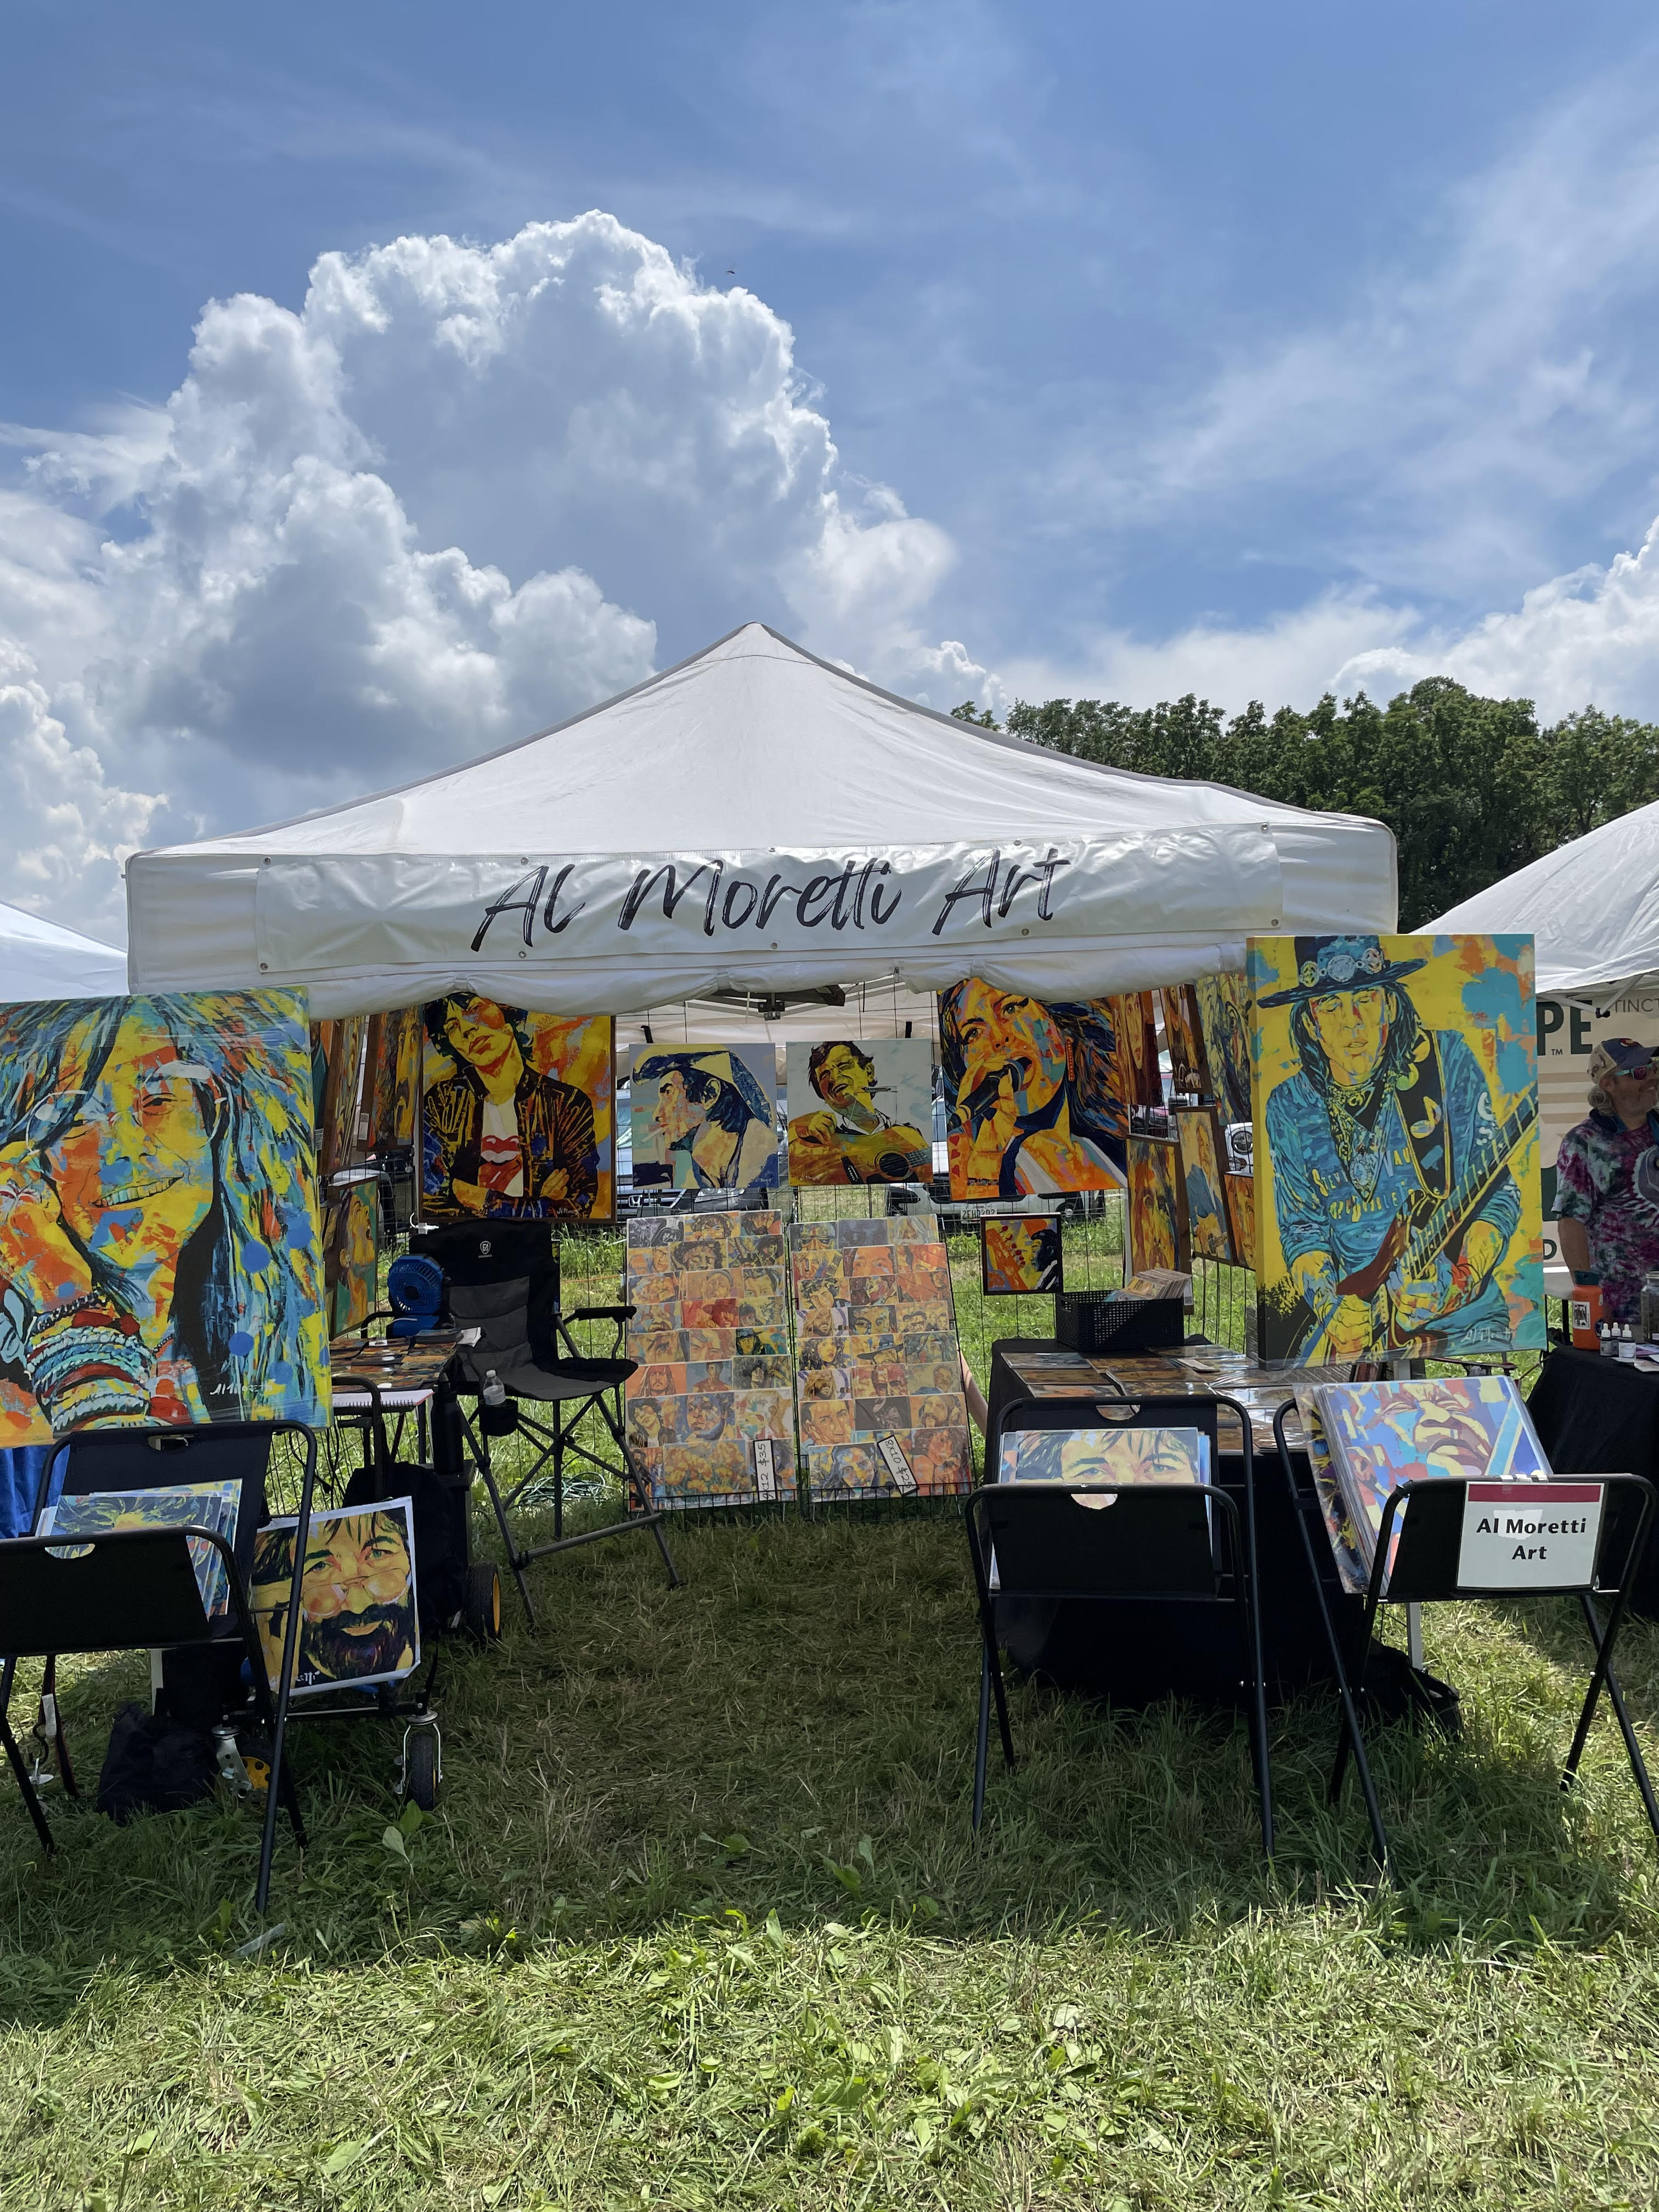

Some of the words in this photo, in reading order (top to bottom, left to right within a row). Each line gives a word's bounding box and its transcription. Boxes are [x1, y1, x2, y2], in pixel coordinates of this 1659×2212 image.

[471, 864, 586, 952] Al
[618, 858, 901, 936] Moretti
[932, 848, 1071, 936] Art
[1476, 1518, 1499, 1533] Al
[1505, 1517, 1587, 1534] Moretti
[1511, 1545, 1547, 1560] Art
